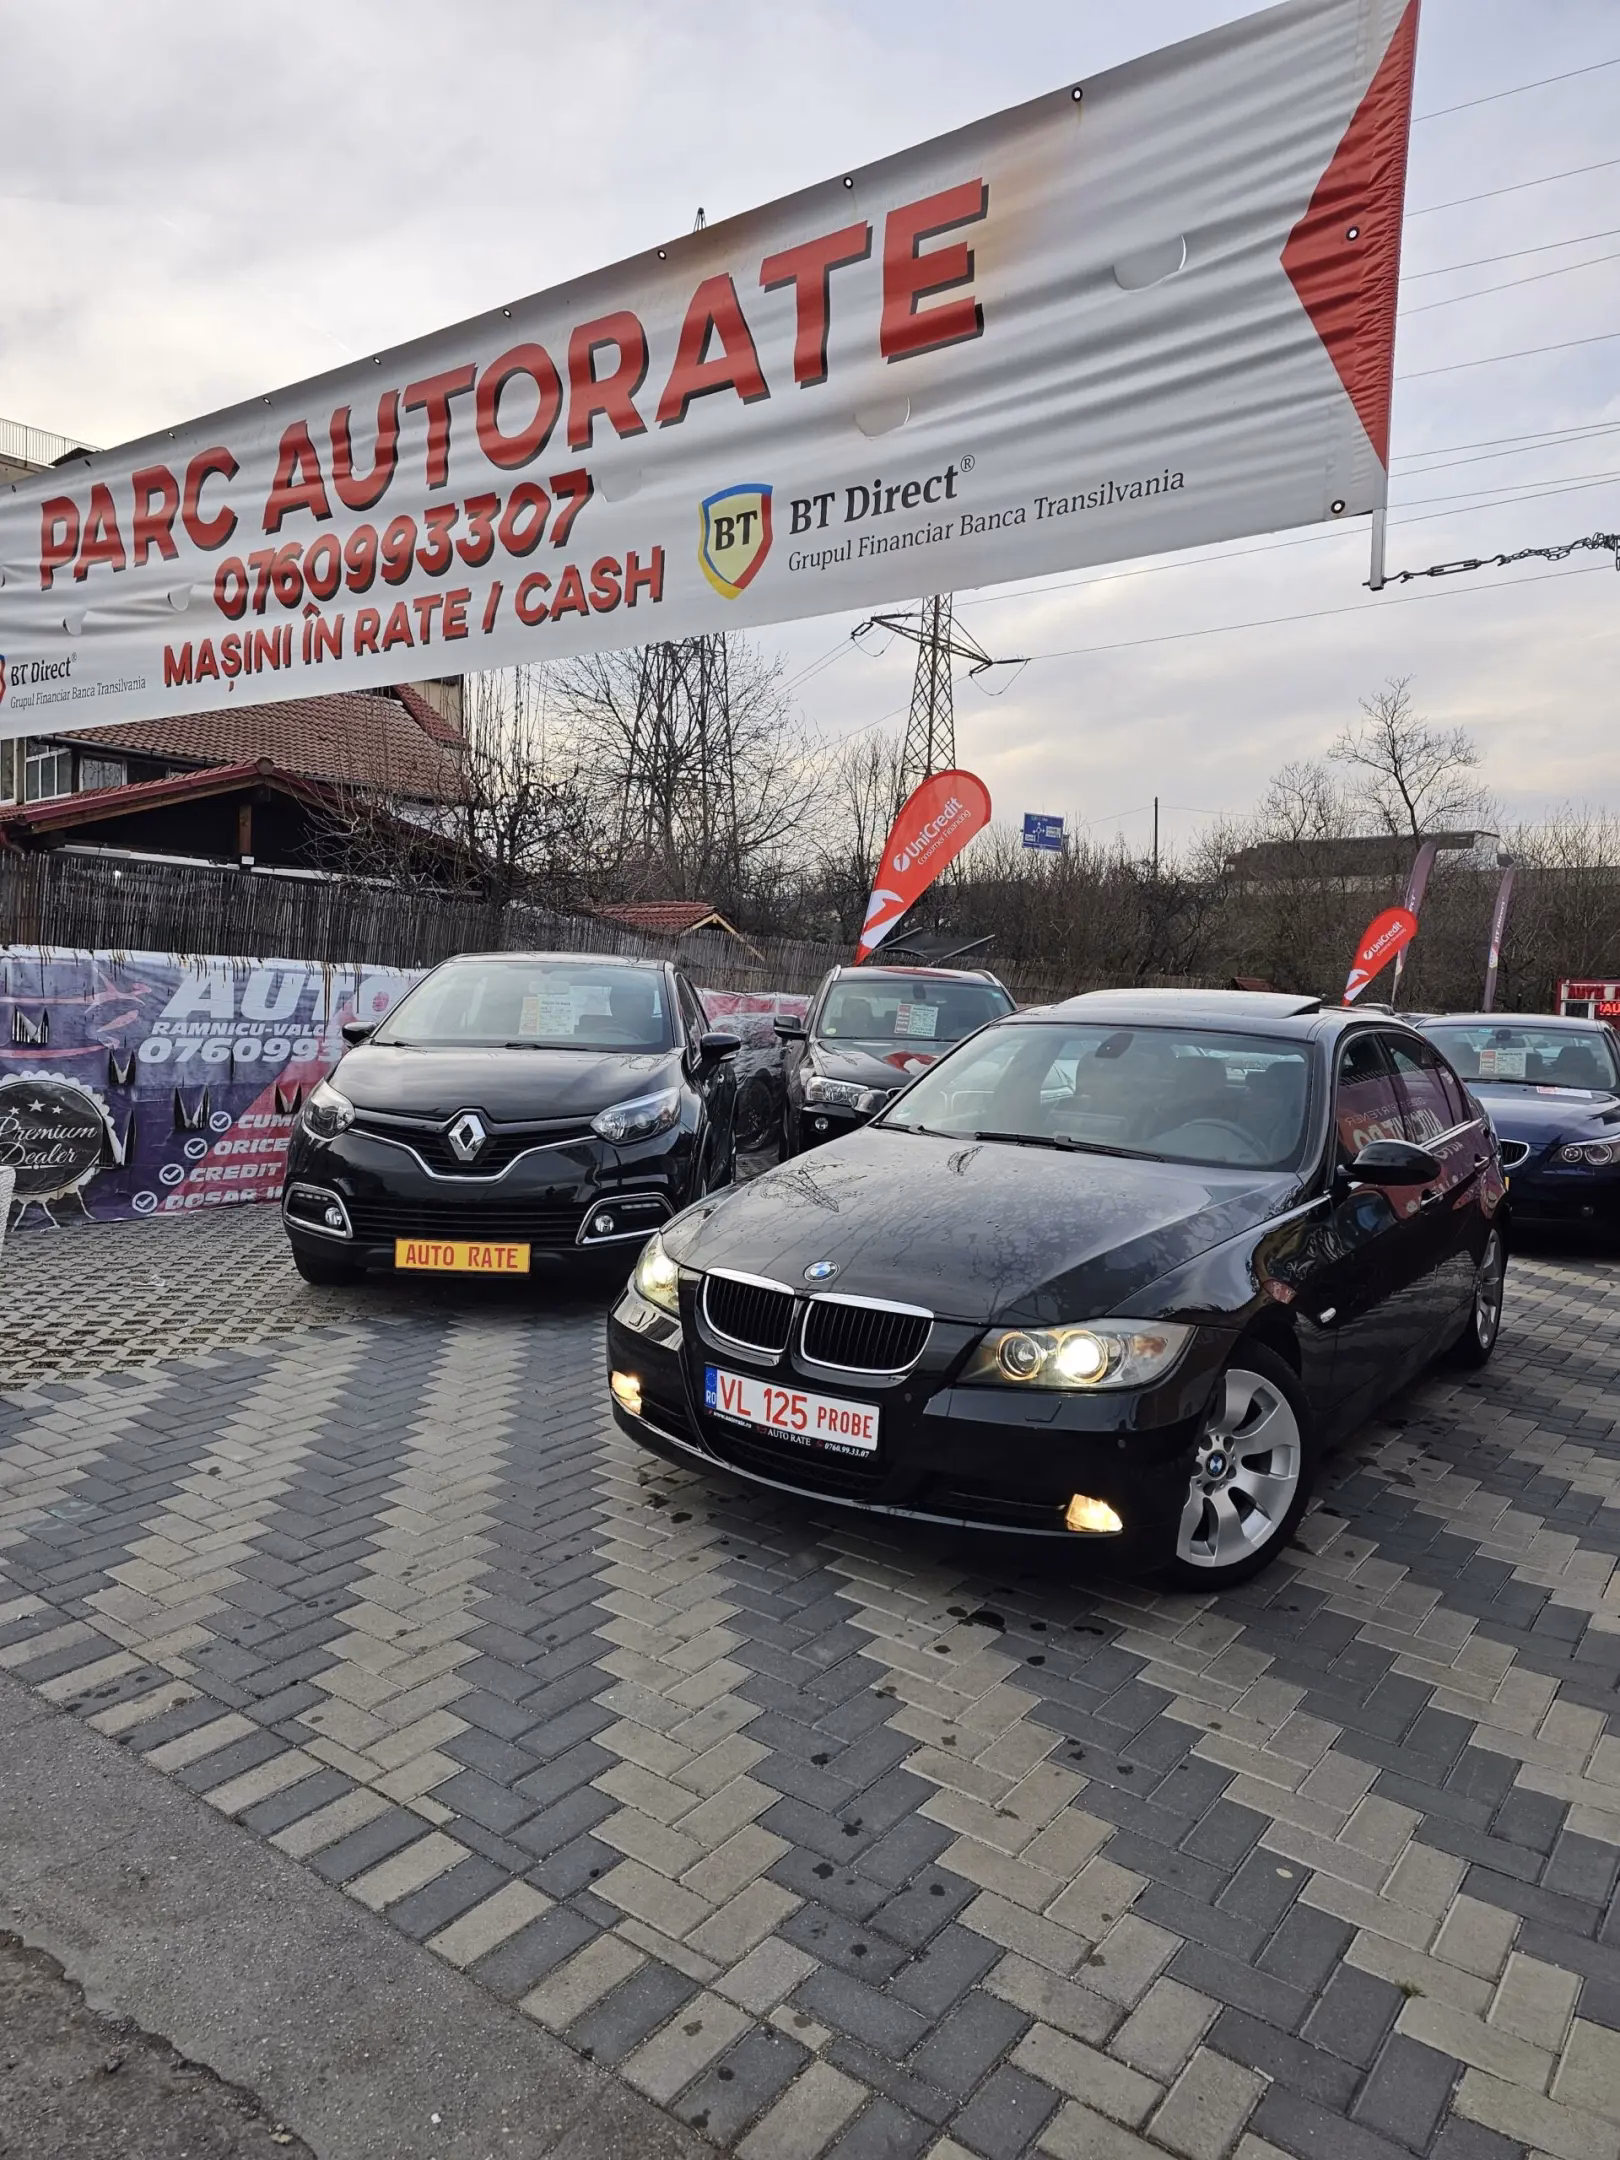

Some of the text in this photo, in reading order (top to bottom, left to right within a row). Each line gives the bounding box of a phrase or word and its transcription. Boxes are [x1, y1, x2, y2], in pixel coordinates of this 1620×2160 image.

[40, 177, 989, 590] PARC AUTORATE
[789, 492, 835, 535] BT
[789, 468, 1185, 573] Grupul Financiar Banca Transilvania
[213, 468, 594, 621] 0760993307
[714, 510, 758, 551] BT
[163, 545, 665, 690] MAȘINI ÎN RATE / CASH
[11, 664, 28, 686] BT
[11, 676, 147, 711] Grupul Financiar Banca Transilvania
[905, 796, 964, 858] UniCredit
[917, 836, 945, 865] Consumer
[1370, 920, 1403, 953] UniCredit
[0, 1114, 97, 1140] Premium
[0, 1141, 77, 1166] Dealer
[213, 1138, 290, 1155] ORICE
[189, 1162, 282, 1183] CREDIT
[164, 1188, 258, 1210] DOSAR
[405, 1243, 518, 1269] AUTO RATE
[706, 1390, 716, 1405] RO
[720, 1375, 873, 1439] VL 125 PROBE
[767, 1429, 812, 1447] AUTO RATE
